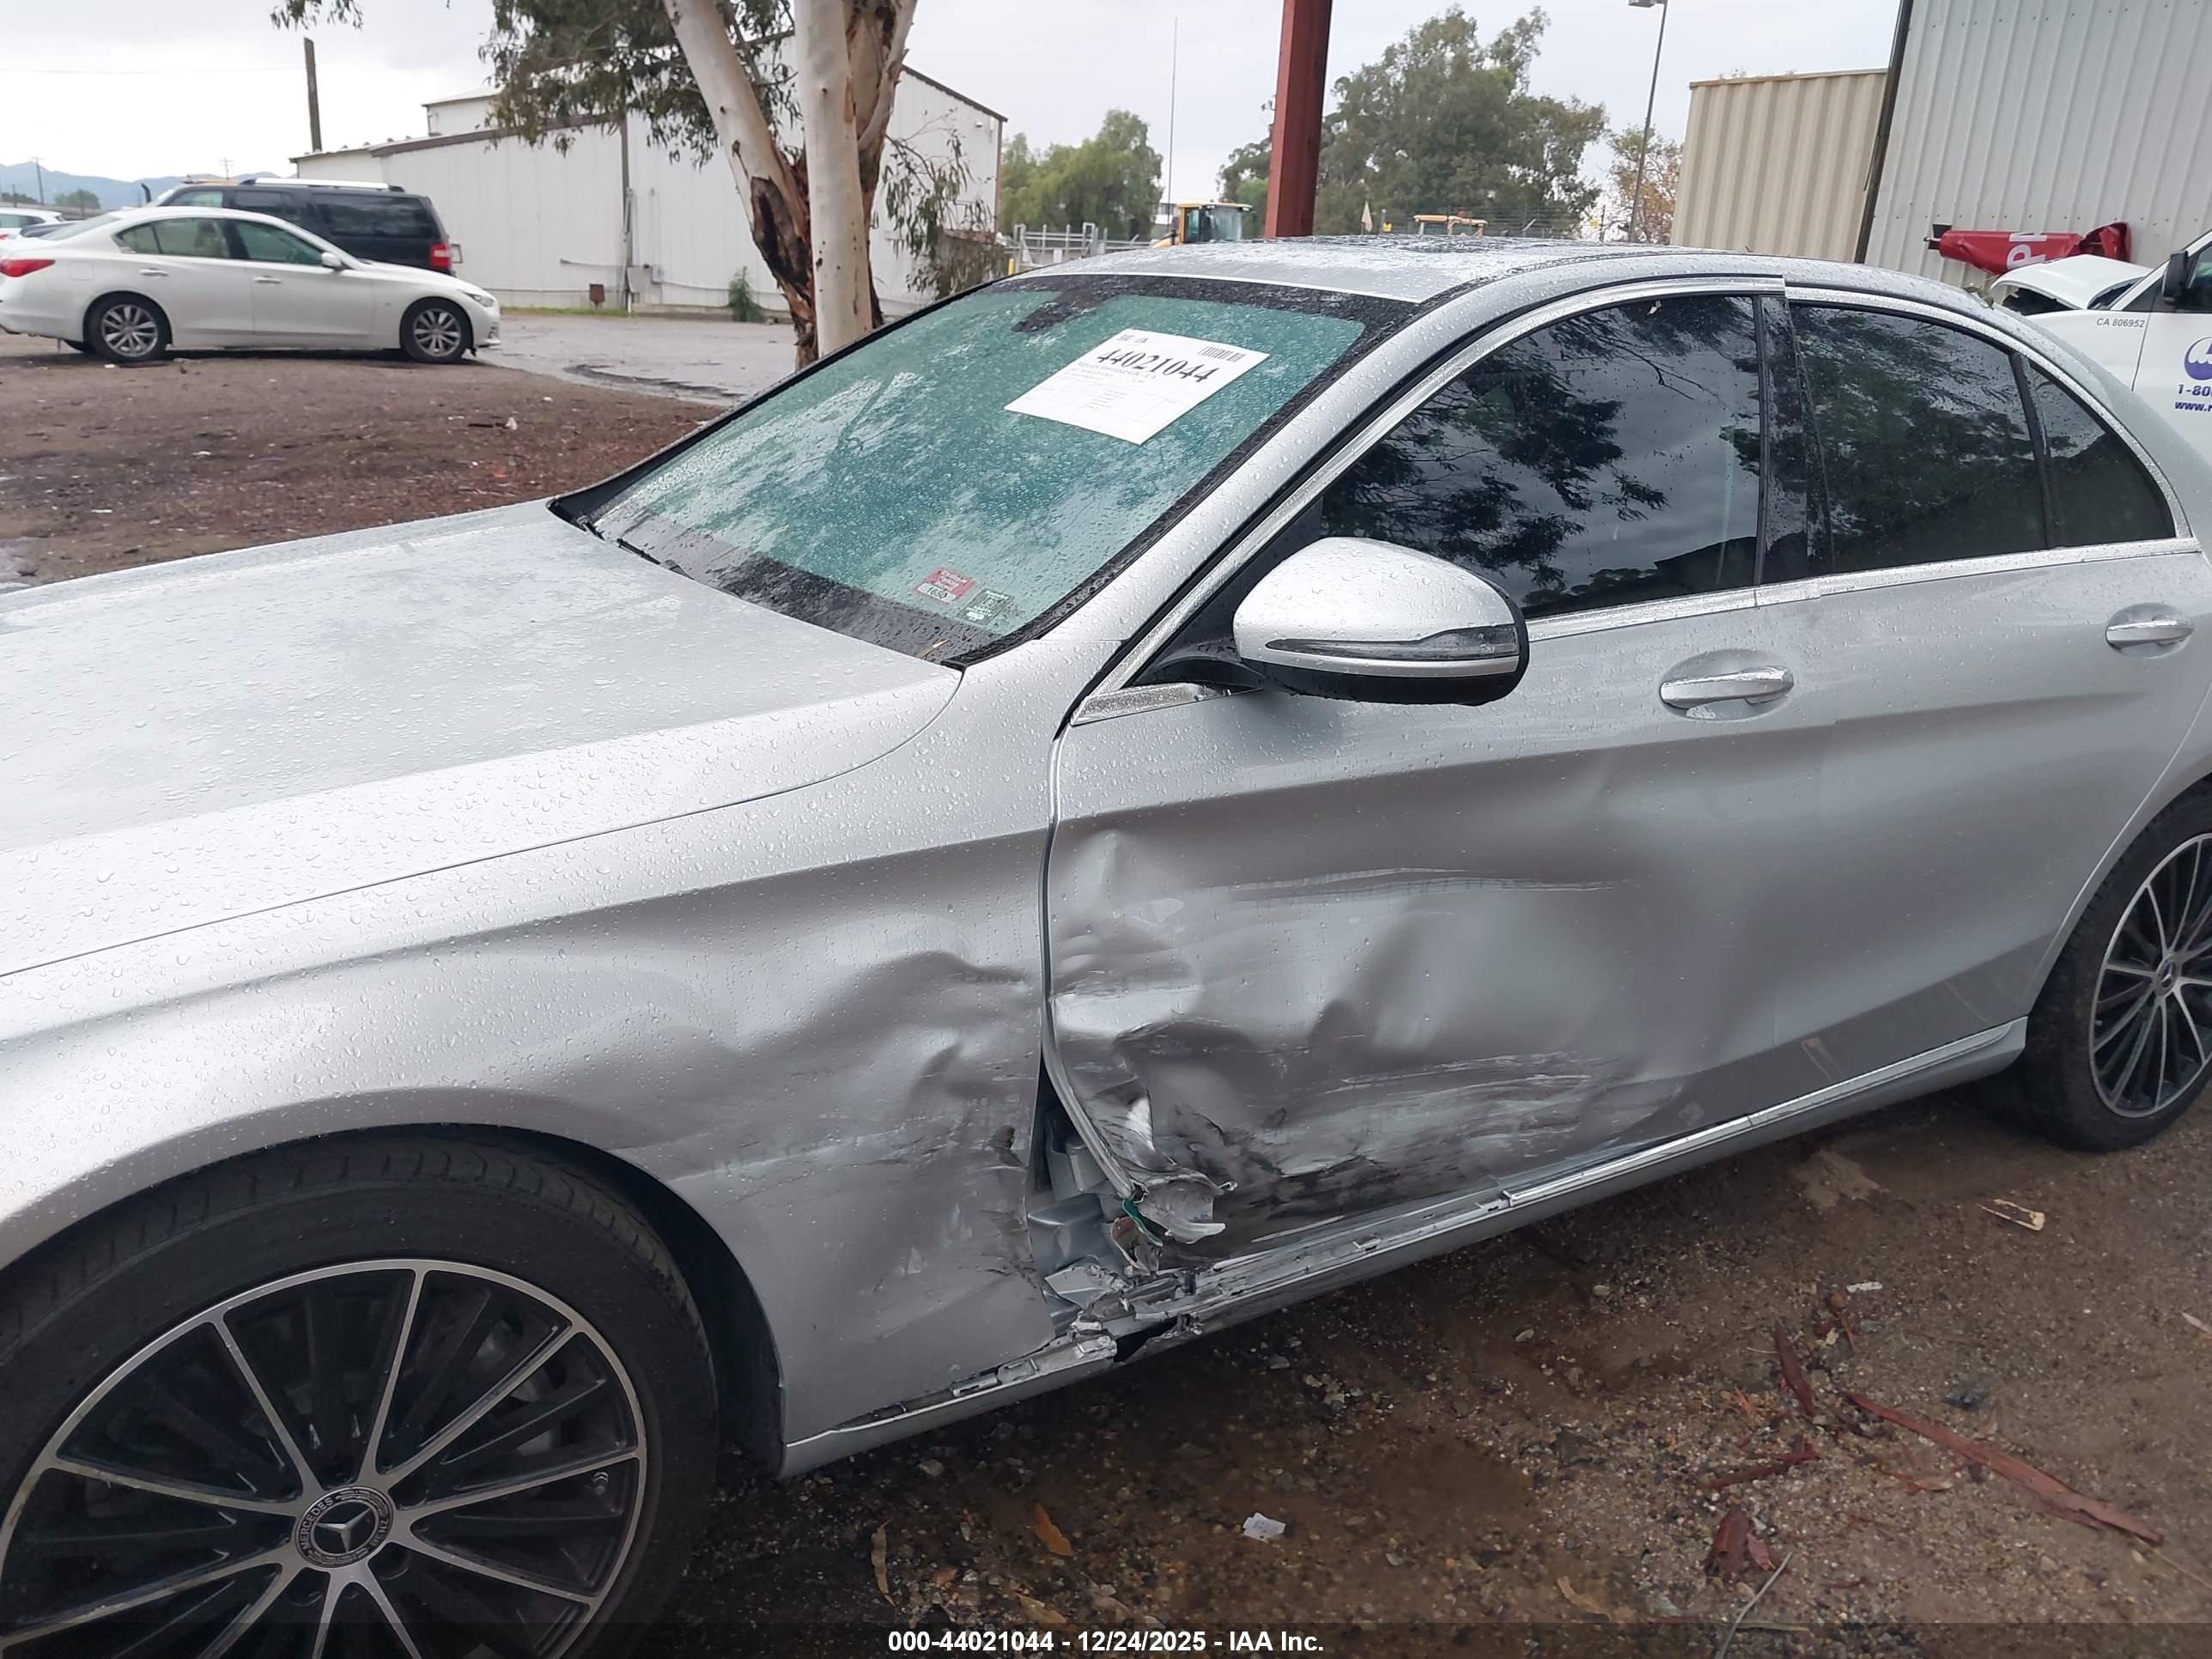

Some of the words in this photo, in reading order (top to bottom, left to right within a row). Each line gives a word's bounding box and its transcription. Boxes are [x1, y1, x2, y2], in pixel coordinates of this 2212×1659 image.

[2096, 317, 2110, 326] CA
[2112, 318, 2145, 328] 806952
[1097, 348, 1220, 382] 44021044
[2178, 384, 2212, 397] 1-80
[301, 1497, 334, 1550] MERCEDES
